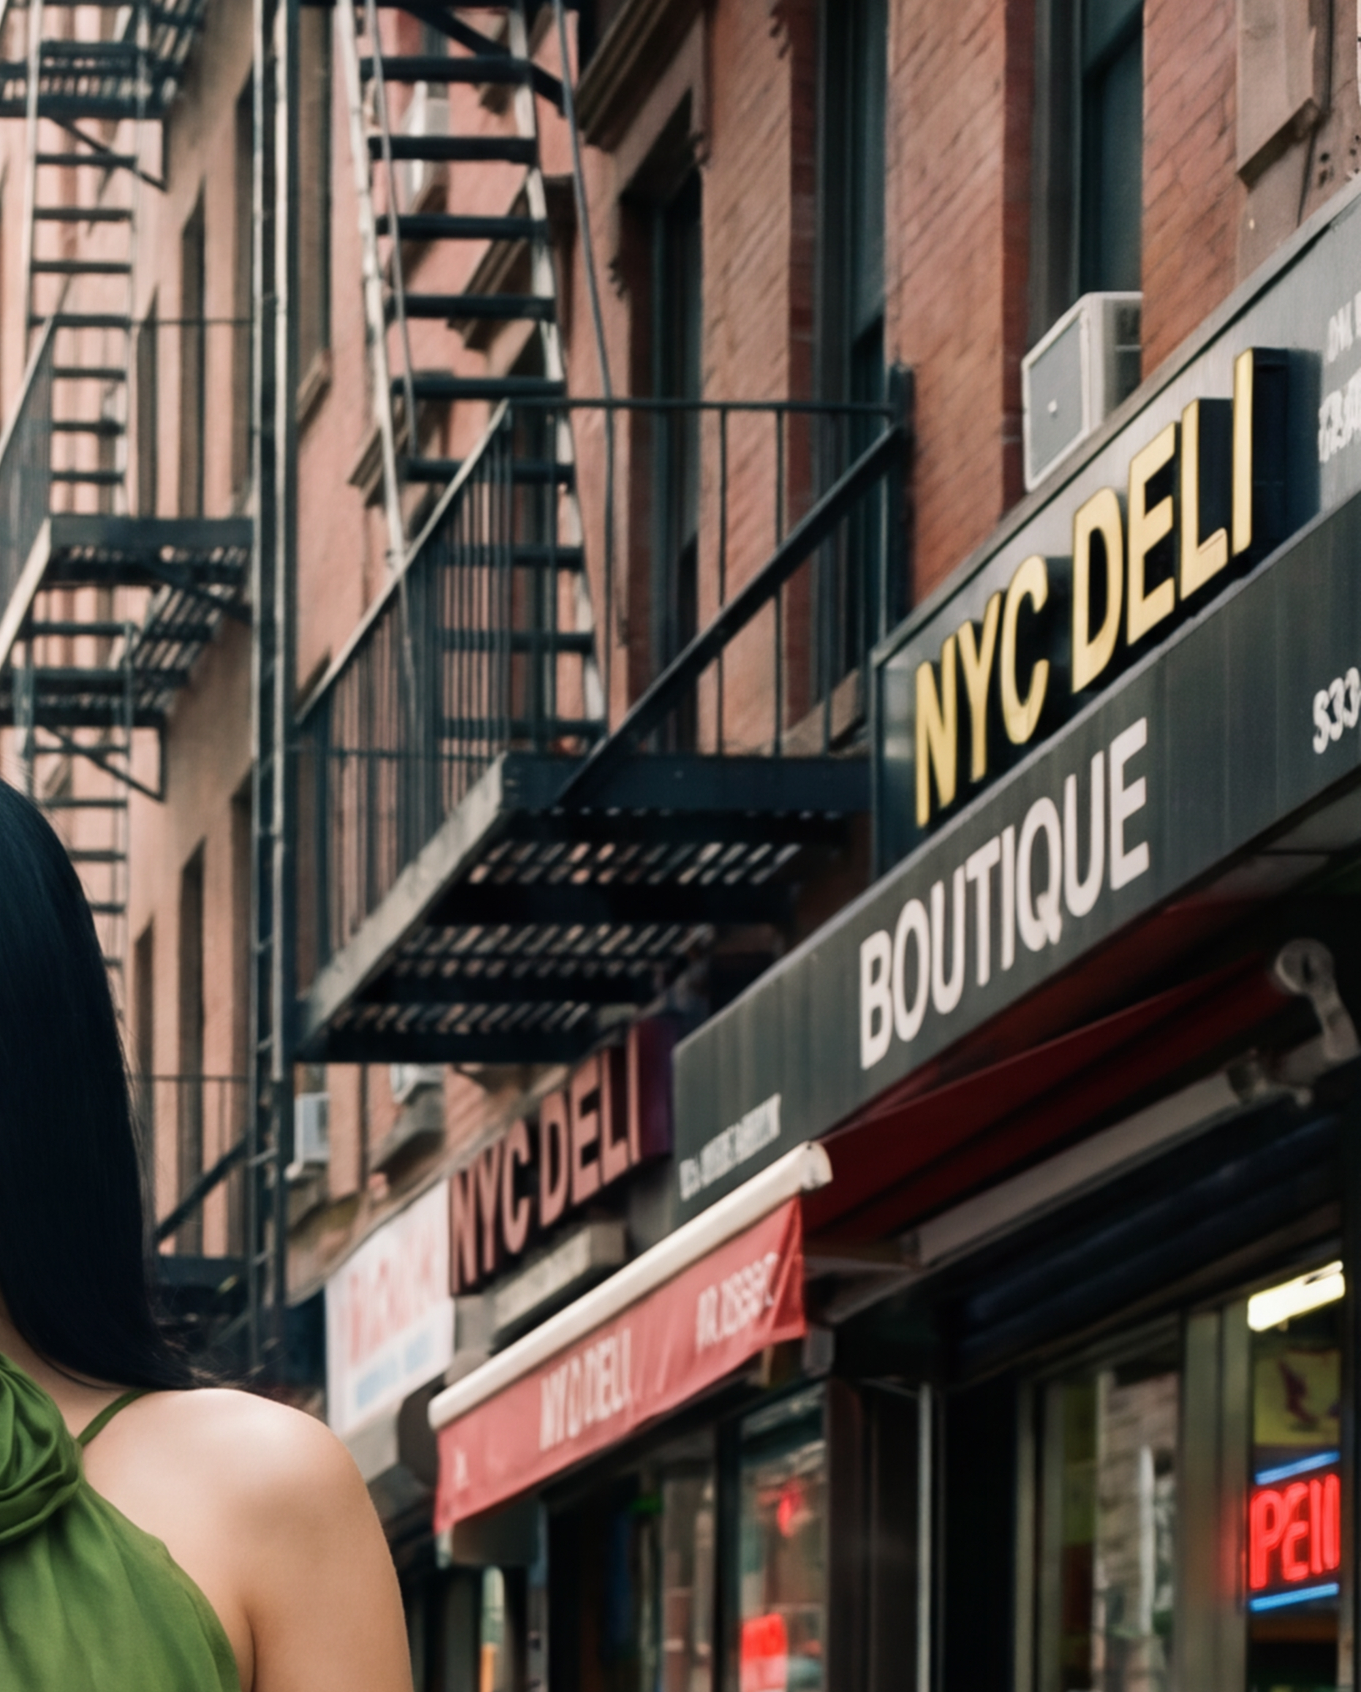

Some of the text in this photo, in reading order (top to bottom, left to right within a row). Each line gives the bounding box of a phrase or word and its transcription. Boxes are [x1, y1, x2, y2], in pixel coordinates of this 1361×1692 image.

[915, 347, 1254, 828] NYC DELI
[860, 717, 1150, 1070] BOUTIQUE
[449, 1120, 530, 1294] NYC
[541, 1026, 640, 1227] DELI
